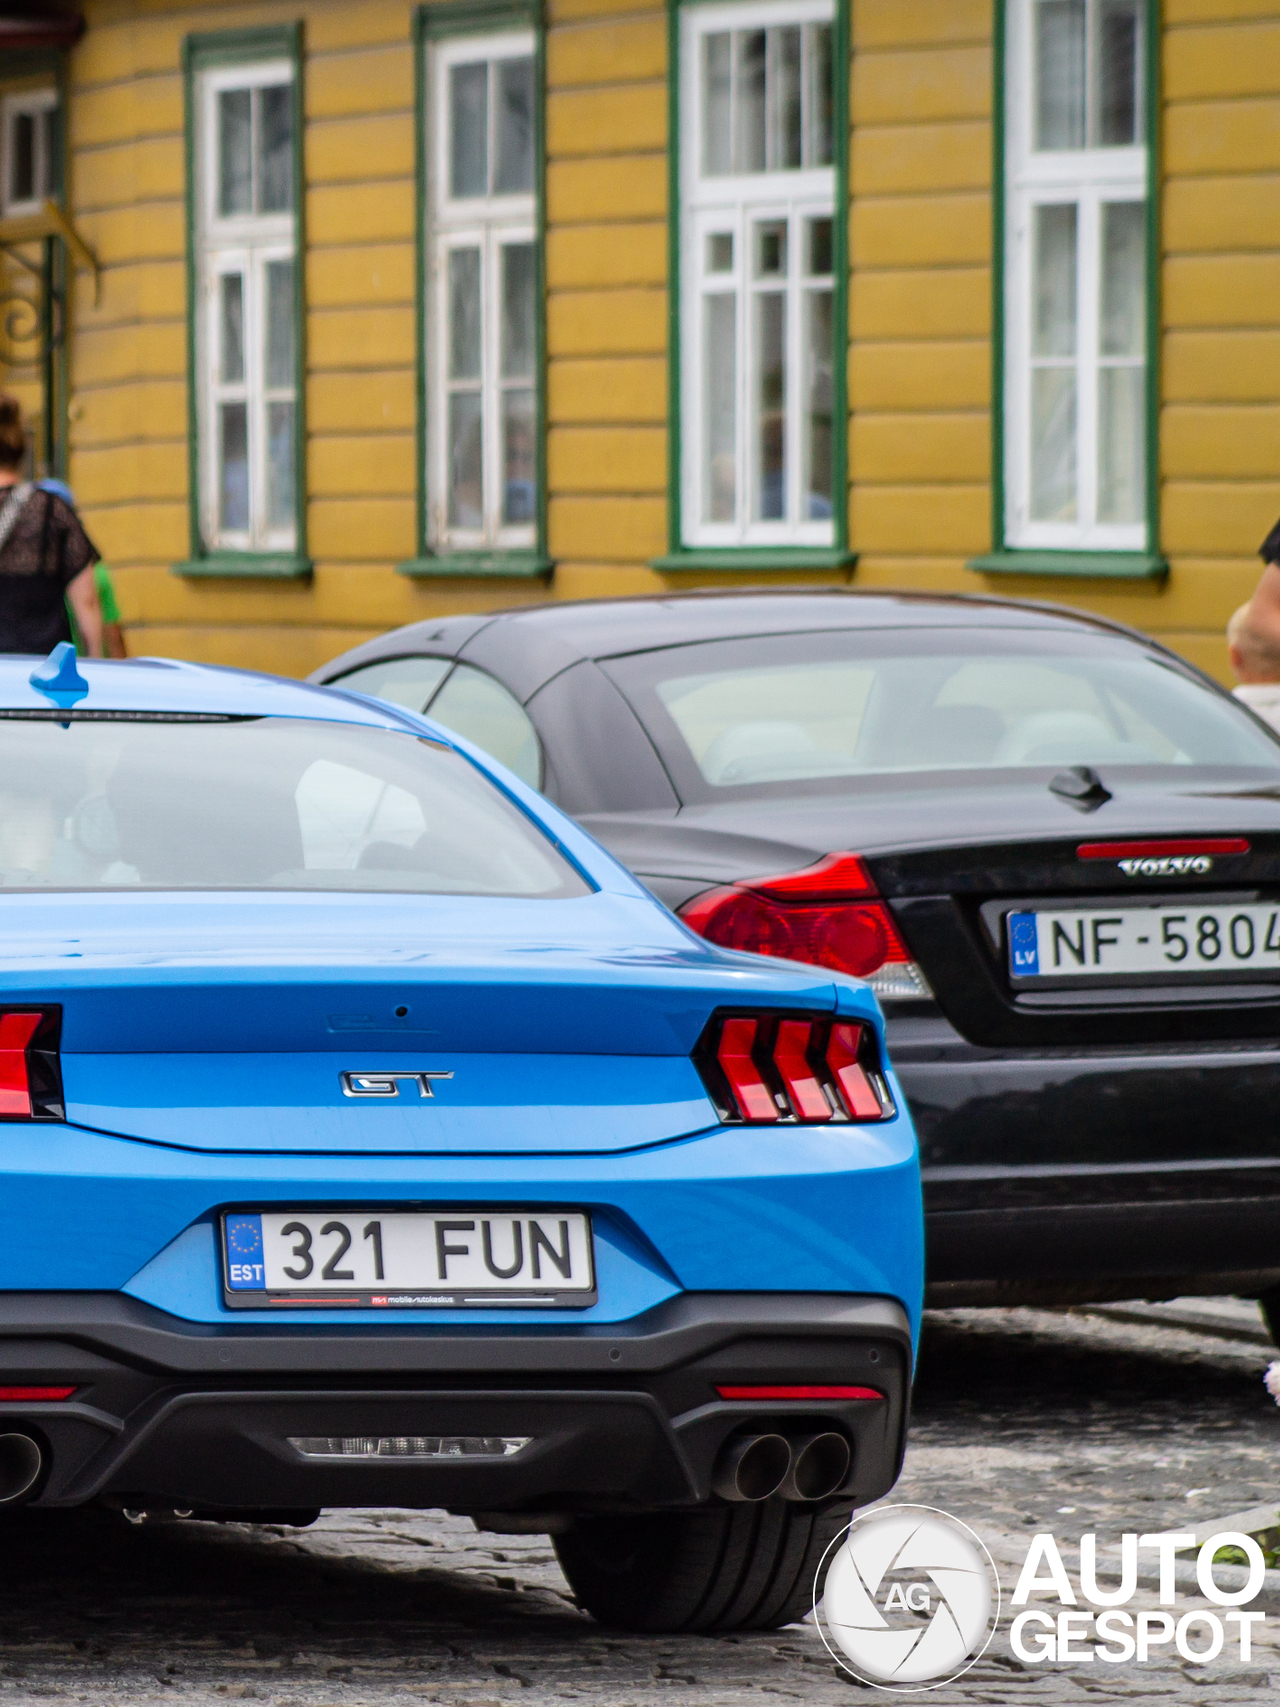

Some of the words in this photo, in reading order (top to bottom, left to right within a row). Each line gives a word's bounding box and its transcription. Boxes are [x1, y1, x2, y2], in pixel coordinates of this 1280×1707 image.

[1118, 856, 1212, 876] VOLVO
[1015, 950, 1036, 965] LV
[338, 1070, 455, 1098] GT
[280, 1221, 385, 1280] 321
[434, 1220, 573, 1280] FUN
[230, 1265, 262, 1281] EST
